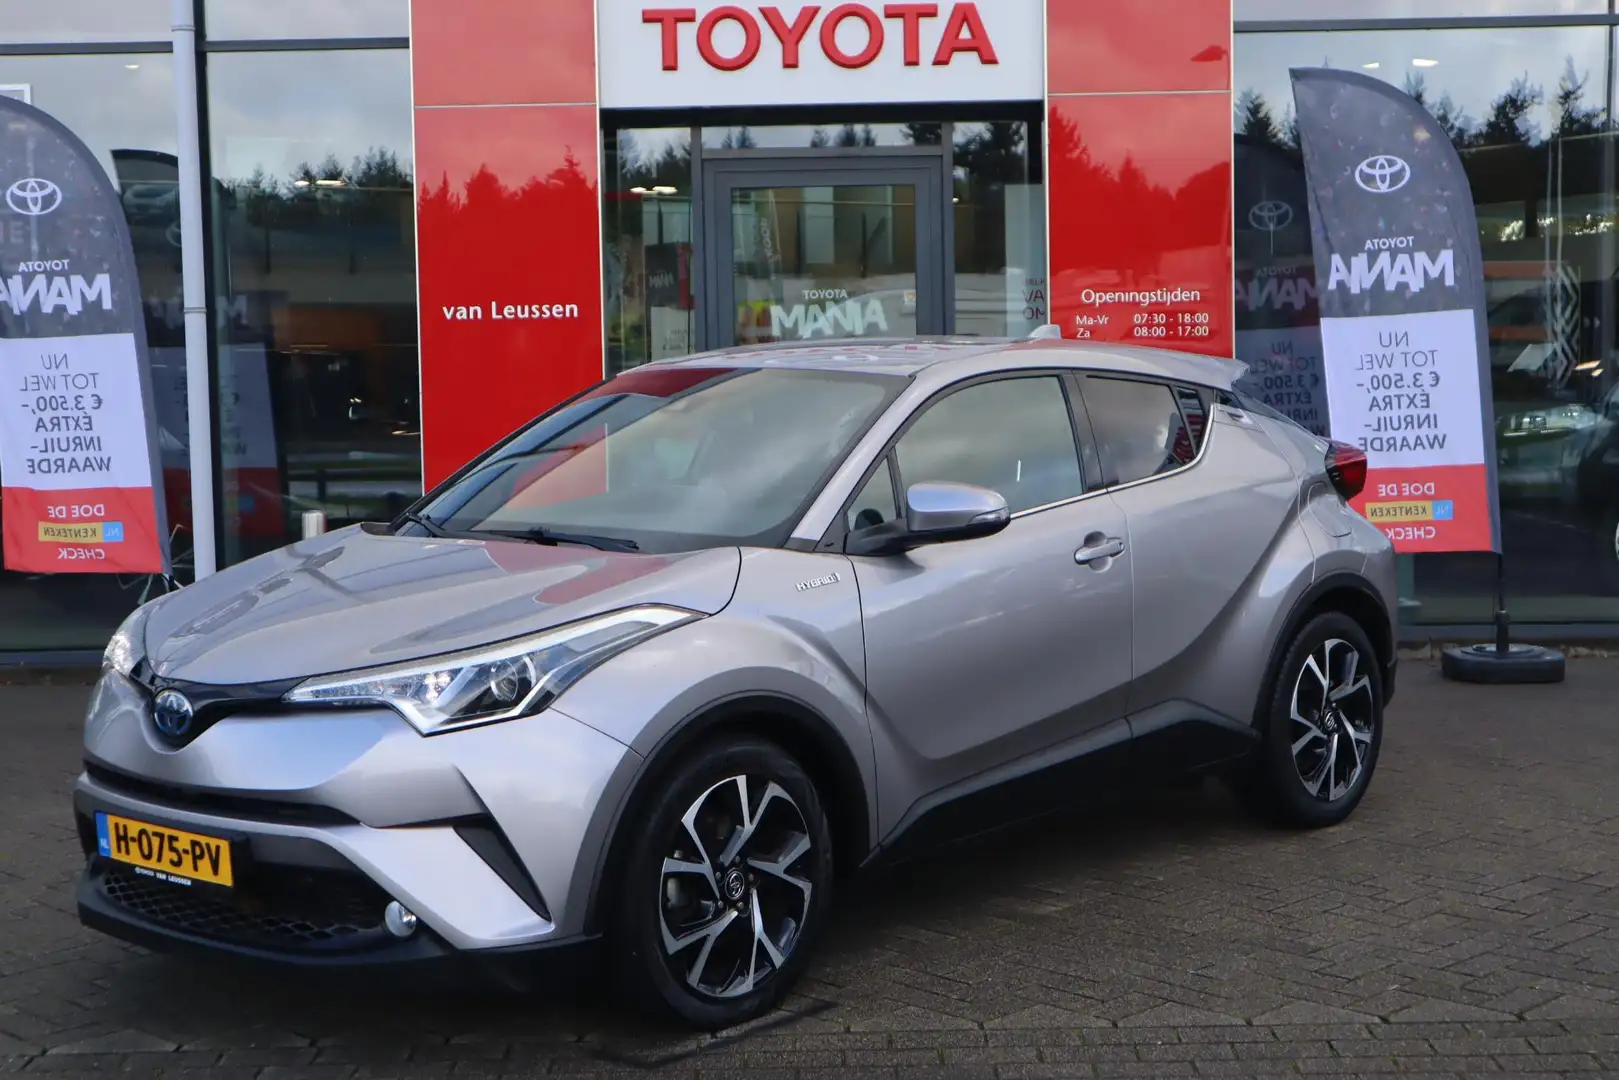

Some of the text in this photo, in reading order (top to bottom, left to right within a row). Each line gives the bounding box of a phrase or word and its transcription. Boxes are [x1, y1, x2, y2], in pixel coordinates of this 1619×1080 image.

[642, 2, 999, 71] TOYOTA
[803, 289, 848, 300] TOYOTA
[1081, 288, 1201, 307] Openingstijden
[442, 301, 579, 320] van Leussen
[769, 297, 889, 339] MANIA
[1076, 314, 1109, 325] Ma-Vr
[1133, 313, 1166, 324] 07:30
[1177, 312, 1209, 323] 18:00
[1076, 328, 1091, 338] Za
[1133, 326, 1166, 337] 08:00
[1177, 325, 1209, 337] 17:00
[795, 574, 835, 592] HYBRID
[114, 822, 221, 876] H-075-PV
